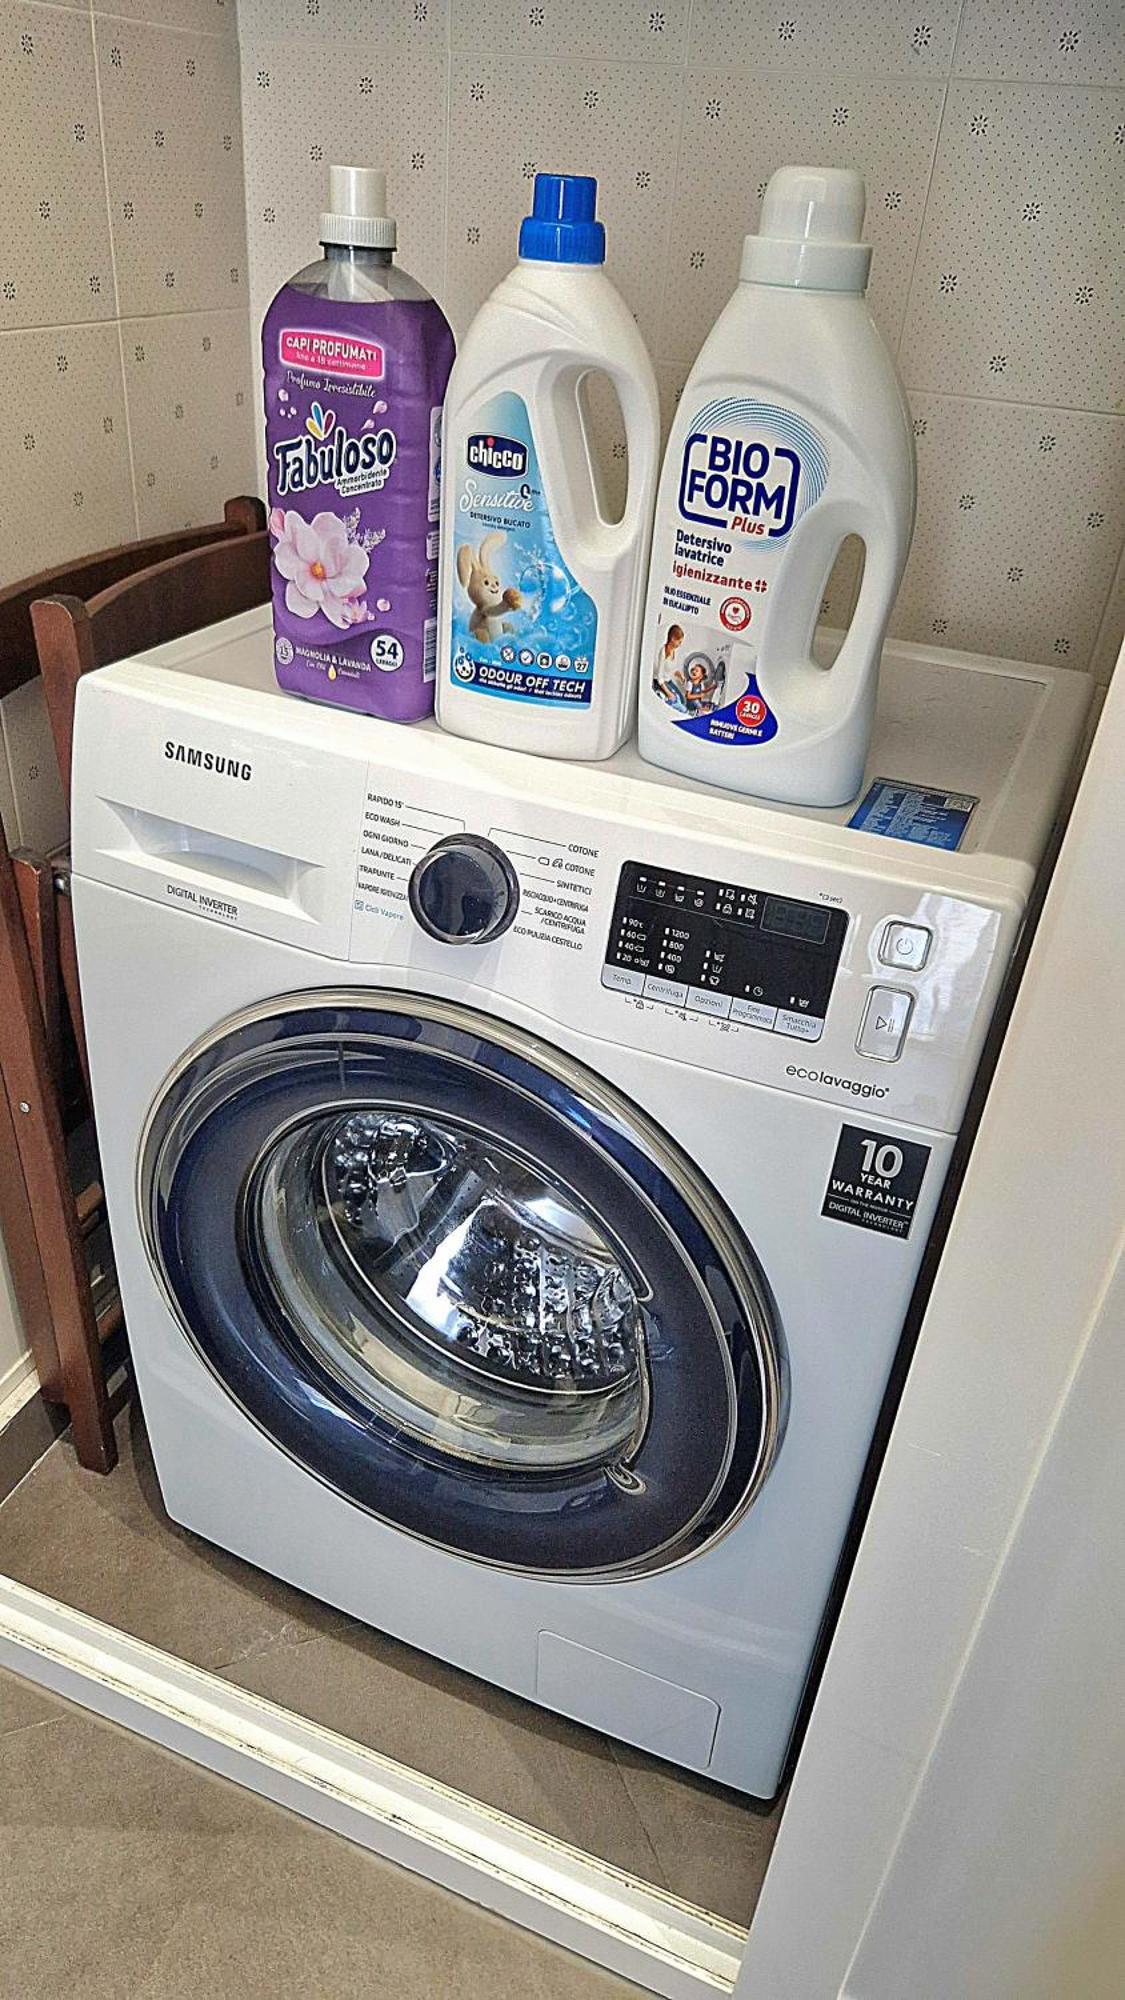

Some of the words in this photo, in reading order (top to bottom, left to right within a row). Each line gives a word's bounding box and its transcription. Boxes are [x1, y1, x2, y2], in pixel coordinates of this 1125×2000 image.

[286, 337, 310, 352] CAPI
[313, 338, 377, 361] PROFUMATI
[287, 370, 321, 390] Profumo
[323, 378, 377, 398] Irresistibile
[275, 428, 395, 494] Fabuloso
[469, 436, 524, 471] chicco
[708, 436, 770, 479] BIO
[336, 468, 387, 486] Ammorbidente
[341, 479, 382, 494] Concentrato
[459, 478, 534, 512] Sensitive
[687, 469, 786, 520] FORM
[469, 511, 502, 524] DETERSIVO
[503, 518, 531, 529] BUCATO
[730, 516, 766, 536] Plus
[676, 529, 732, 554] Detersivo
[674, 543, 725, 567] lavatrice
[672, 561, 753, 591] igienizzante
[664, 586, 677, 597] OLIO
[676, 589, 712, 606] ESSENZIALE
[669, 599, 699, 615] EUCALIPTO
[375, 640, 399, 660] 54
[295, 646, 331, 663] MAGNOLIA
[331, 655, 338, 664] &
[338, 657, 372, 673] LAVANDA
[479, 666, 523, 685] ODOUR
[525, 676, 550, 689] OFF
[553, 680, 586, 693] TECH
[743, 700, 760, 714] 30
[164, 741, 253, 781] SAMSUNG
[367, 793, 394, 808] RAPIDO
[364, 811, 380, 822] ECO
[380, 816, 401, 827] WASH
[362, 830, 381, 841] OGNI
[380, 834, 409, 848] GIORNO
[568, 844, 600, 858] COTONE
[359, 864, 396, 881] TRAPUNTE
[564, 863, 596, 877] COTONE
[357, 882, 380, 894] VAPORE
[556, 880, 593, 896] SINTETICI
[167, 884, 198, 903] DIGITAL
[198, 895, 238, 916] INVERTER
[534, 906, 563, 920] SCARICO
[563, 915, 586, 927] ACQUA
[512, 925, 526, 935] ECO
[526, 929, 551, 941] PULIZIA
[551, 936, 583, 950] CESTELLO
[626, 930, 637, 939] 60
[671, 929, 690, 940] 1200
[624, 942, 634, 950] 40
[668, 940, 685, 951] 800
[621, 954, 632, 962] 20
[667, 953, 682, 963] 400
[647, 983, 684, 999] Centrifuga
[695, 995, 722, 1008] Opzioni
[782, 1014, 817, 1030] Smacchia
[860, 1138, 904, 1179] 10
[860, 1173, 892, 1190] YEAR
[832, 1179, 914, 1211] WARRANTY
[828, 1201, 862, 1217] DIGITAL
